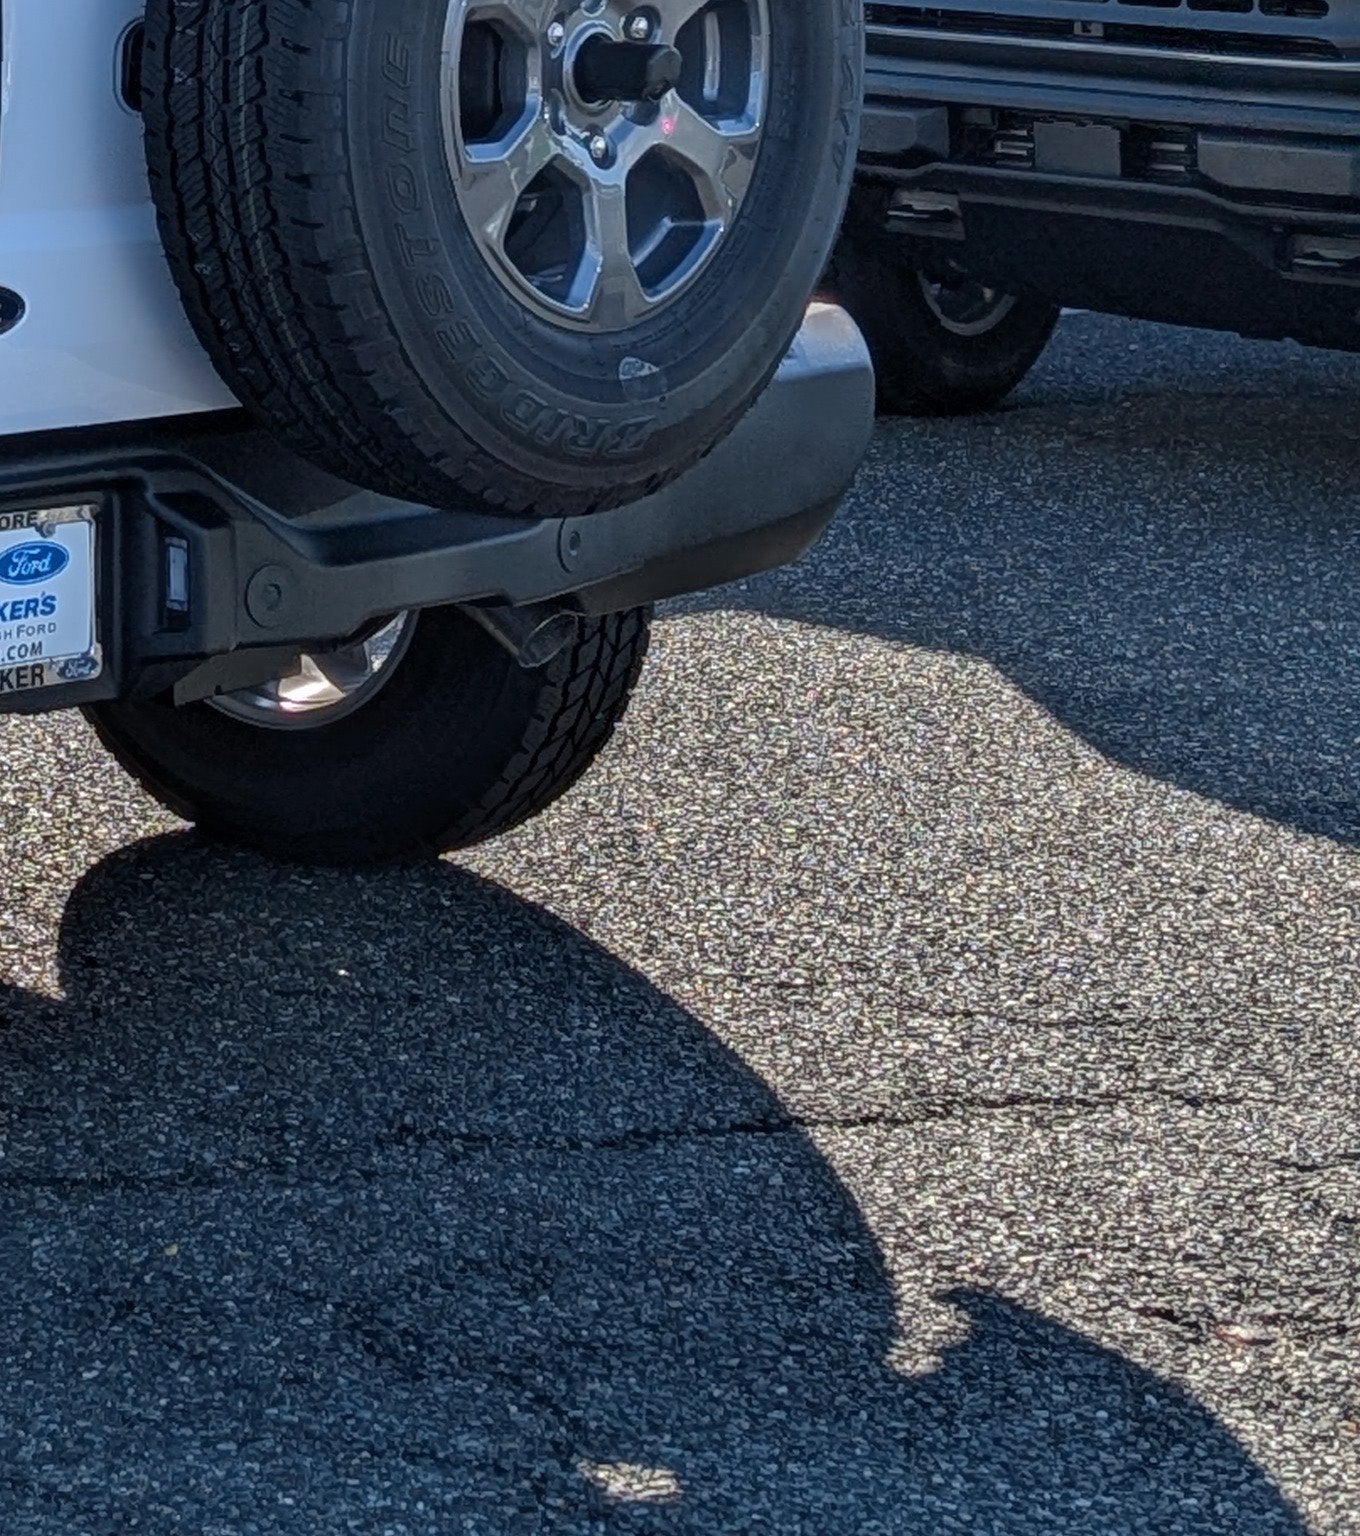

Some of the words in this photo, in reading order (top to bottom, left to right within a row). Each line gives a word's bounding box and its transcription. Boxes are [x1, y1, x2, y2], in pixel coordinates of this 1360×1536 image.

[377, 30, 658, 458] BRIDGESTONE
[7, 549, 52, 577] Ford
[16, 621, 57, 638] FORD
